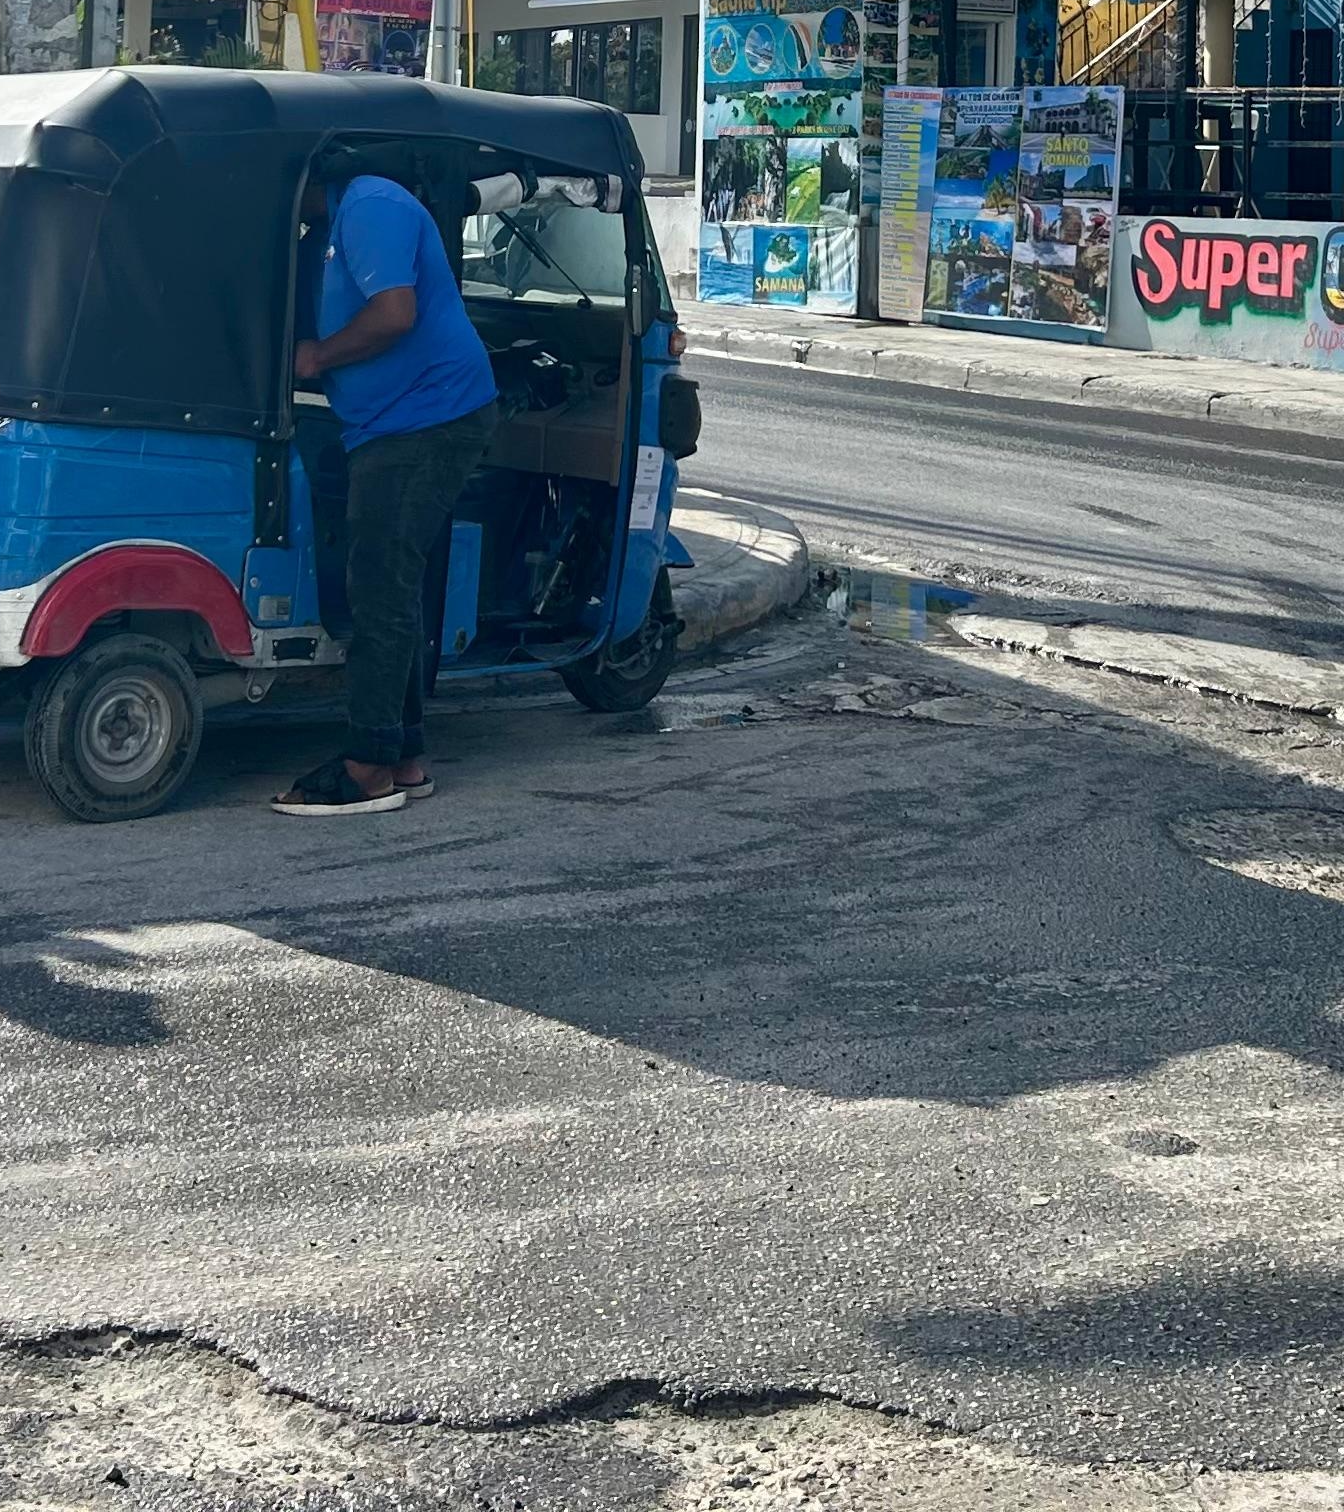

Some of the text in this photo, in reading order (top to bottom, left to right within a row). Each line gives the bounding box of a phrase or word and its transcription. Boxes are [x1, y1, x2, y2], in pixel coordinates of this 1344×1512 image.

[1046, 137, 1090, 152] SANTO
[1042, 154, 1091, 168] DOMINGO
[1136, 223, 1308, 310] Super
